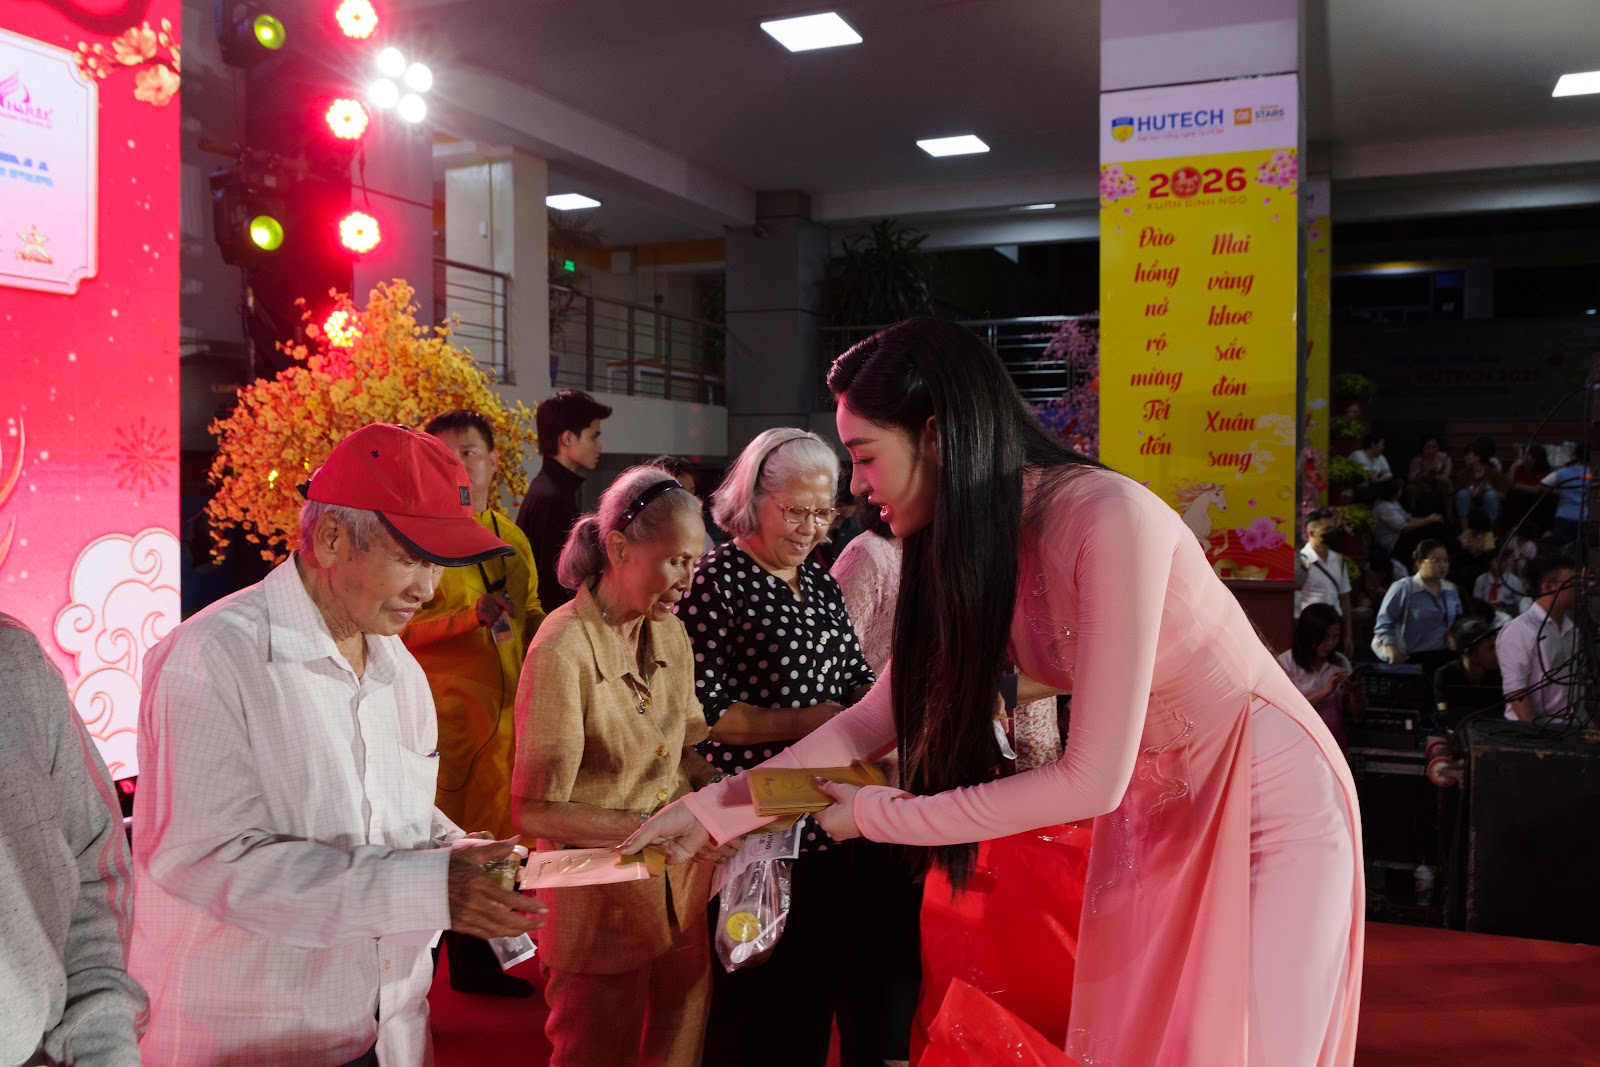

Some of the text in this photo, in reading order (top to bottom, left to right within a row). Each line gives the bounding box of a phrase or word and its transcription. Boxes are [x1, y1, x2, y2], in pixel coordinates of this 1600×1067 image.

[1137, 108, 1224, 132] HUTECH
[1149, 167, 1247, 199] 2026
[1139, 226, 1176, 248] Đào
[1211, 232, 1251, 256] Mai
[1207, 270, 1254, 296] vàng
[1208, 304, 1253, 326] khoe
[1146, 332, 1167, 356] rộ
[1216, 337, 1246, 361] sắc
[1212, 375, 1248, 397] đón
[1143, 398, 1171, 421] Tết
[1204, 410, 1255, 433] Xuân
[1139, 432, 1172, 455] đến
[1208, 451, 1252, 474] sang
